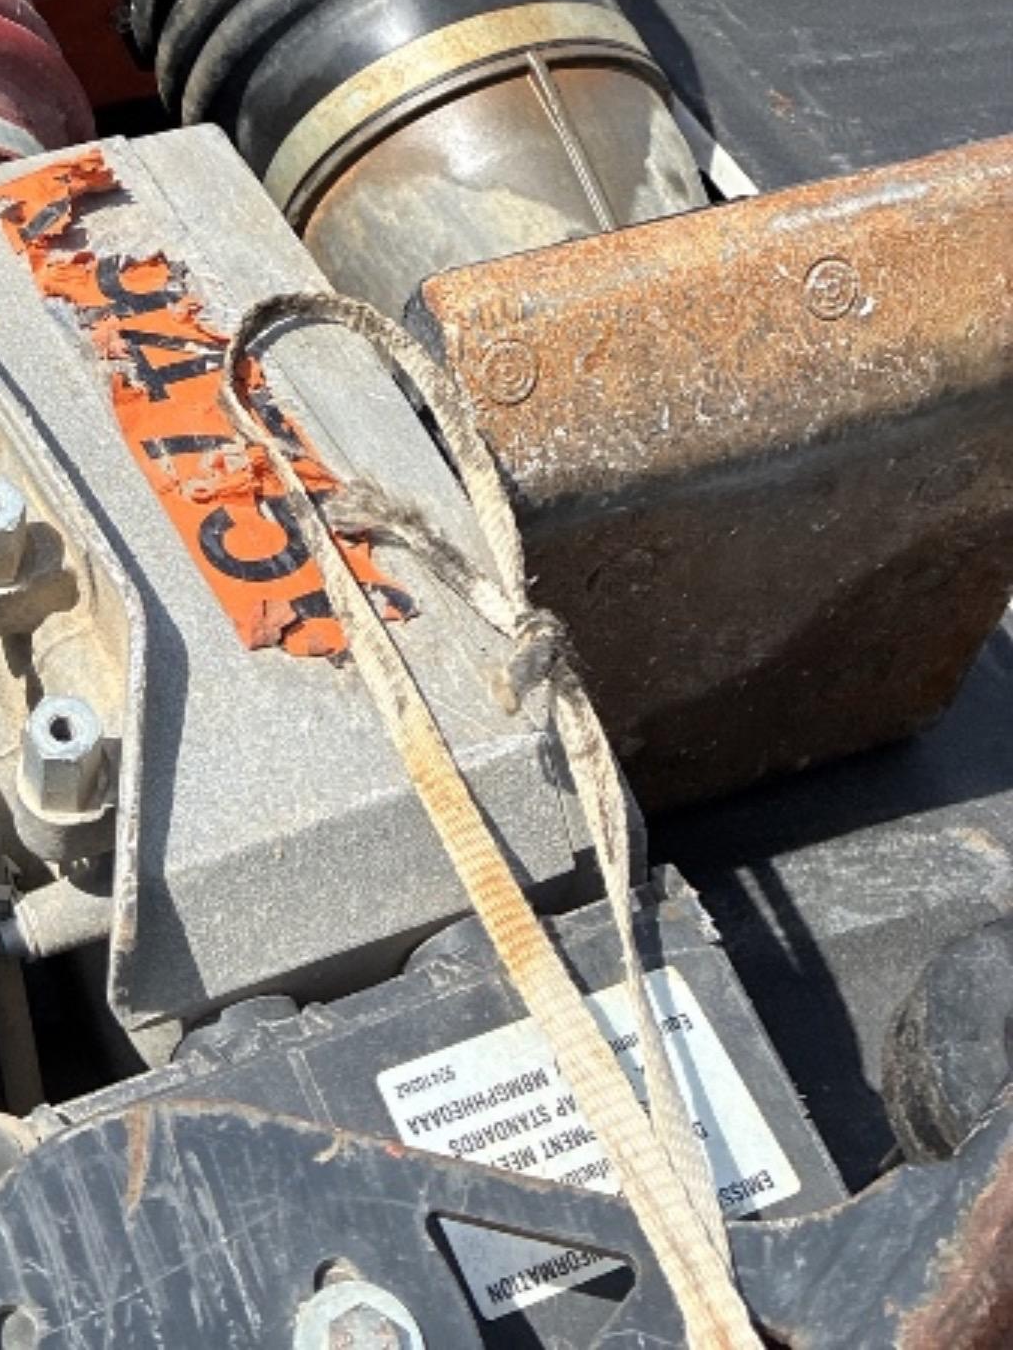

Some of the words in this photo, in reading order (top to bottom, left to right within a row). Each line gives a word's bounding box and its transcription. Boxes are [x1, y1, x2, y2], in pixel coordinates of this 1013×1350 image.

[556, 1093, 578, 1117] AP
[449, 1104, 552, 1155] STANDARDS
[717, 1169, 775, 1207] EMISS
[485, 1250, 604, 1305] NFORMATION
